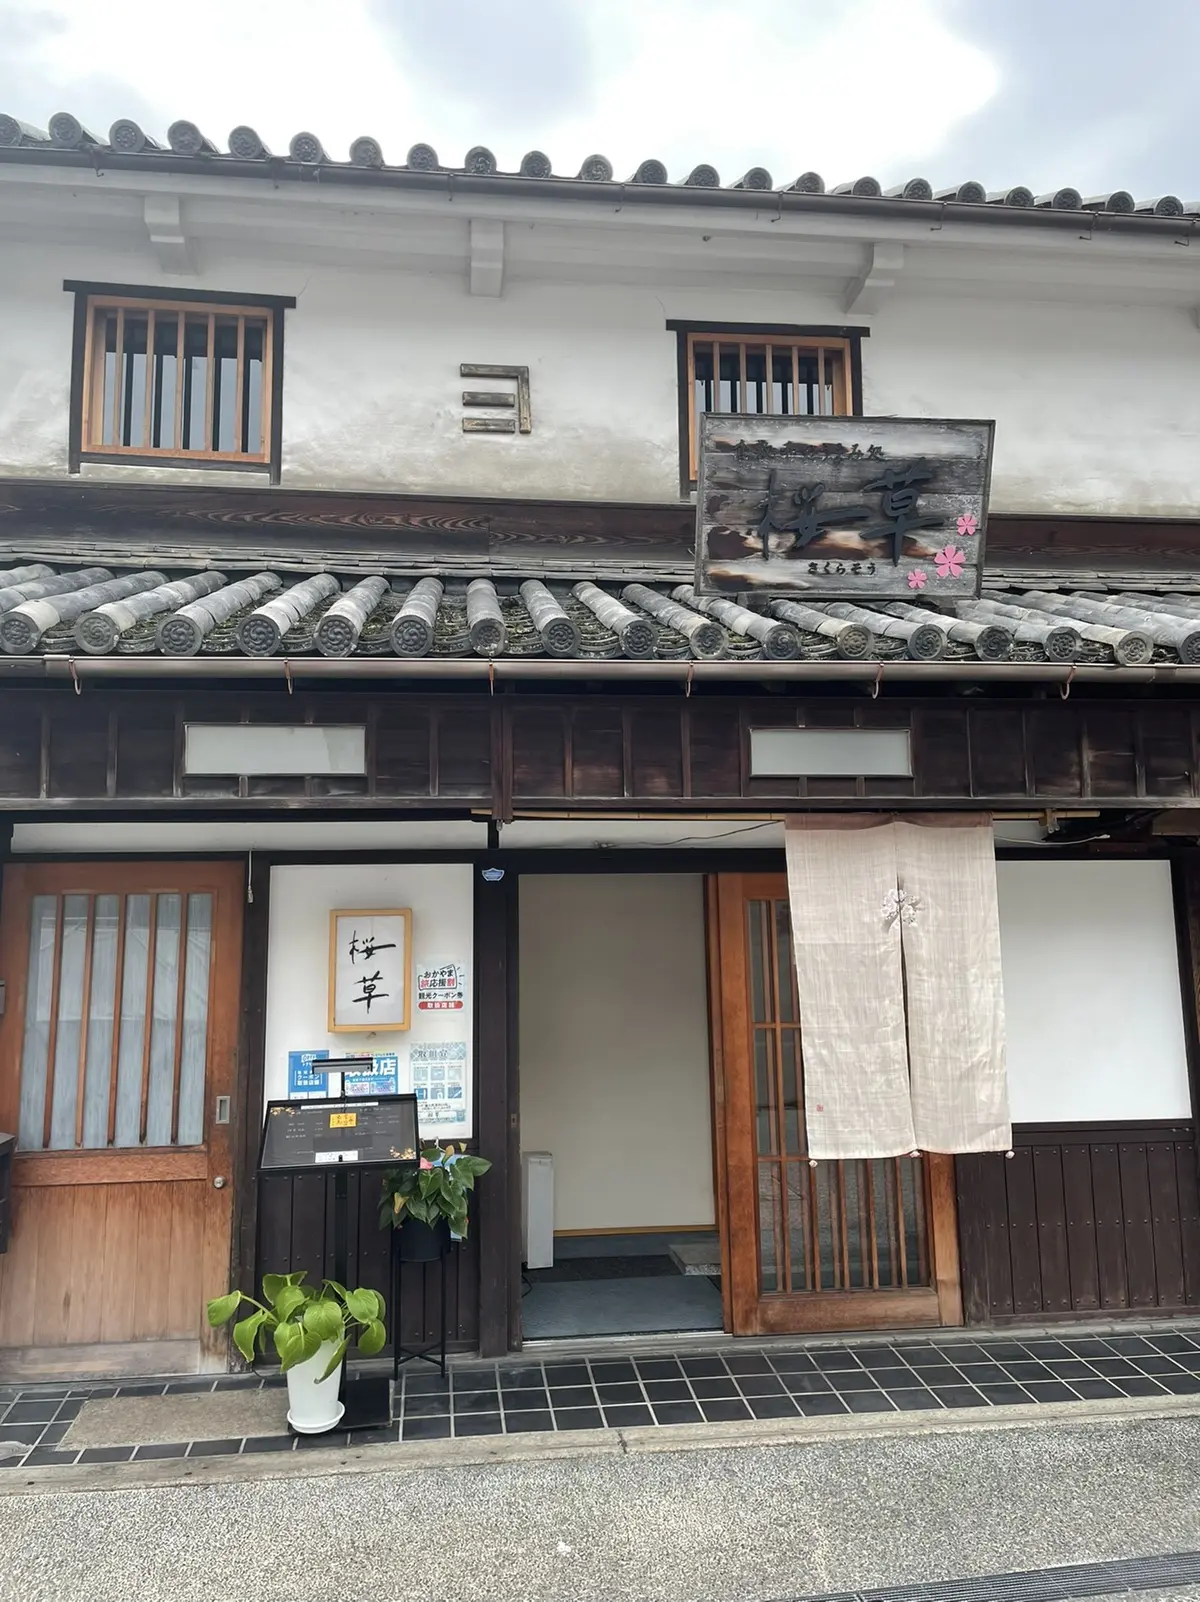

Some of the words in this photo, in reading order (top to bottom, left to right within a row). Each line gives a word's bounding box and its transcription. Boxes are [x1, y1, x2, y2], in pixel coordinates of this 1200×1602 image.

[757, 457, 946, 567] 桜草
[807, 561, 877, 576] さくらそう
[350, 930, 396, 1013] 桜草
[423, 969, 454, 978] おかやま
[418, 991, 464, 1000] 観光クーポン券
